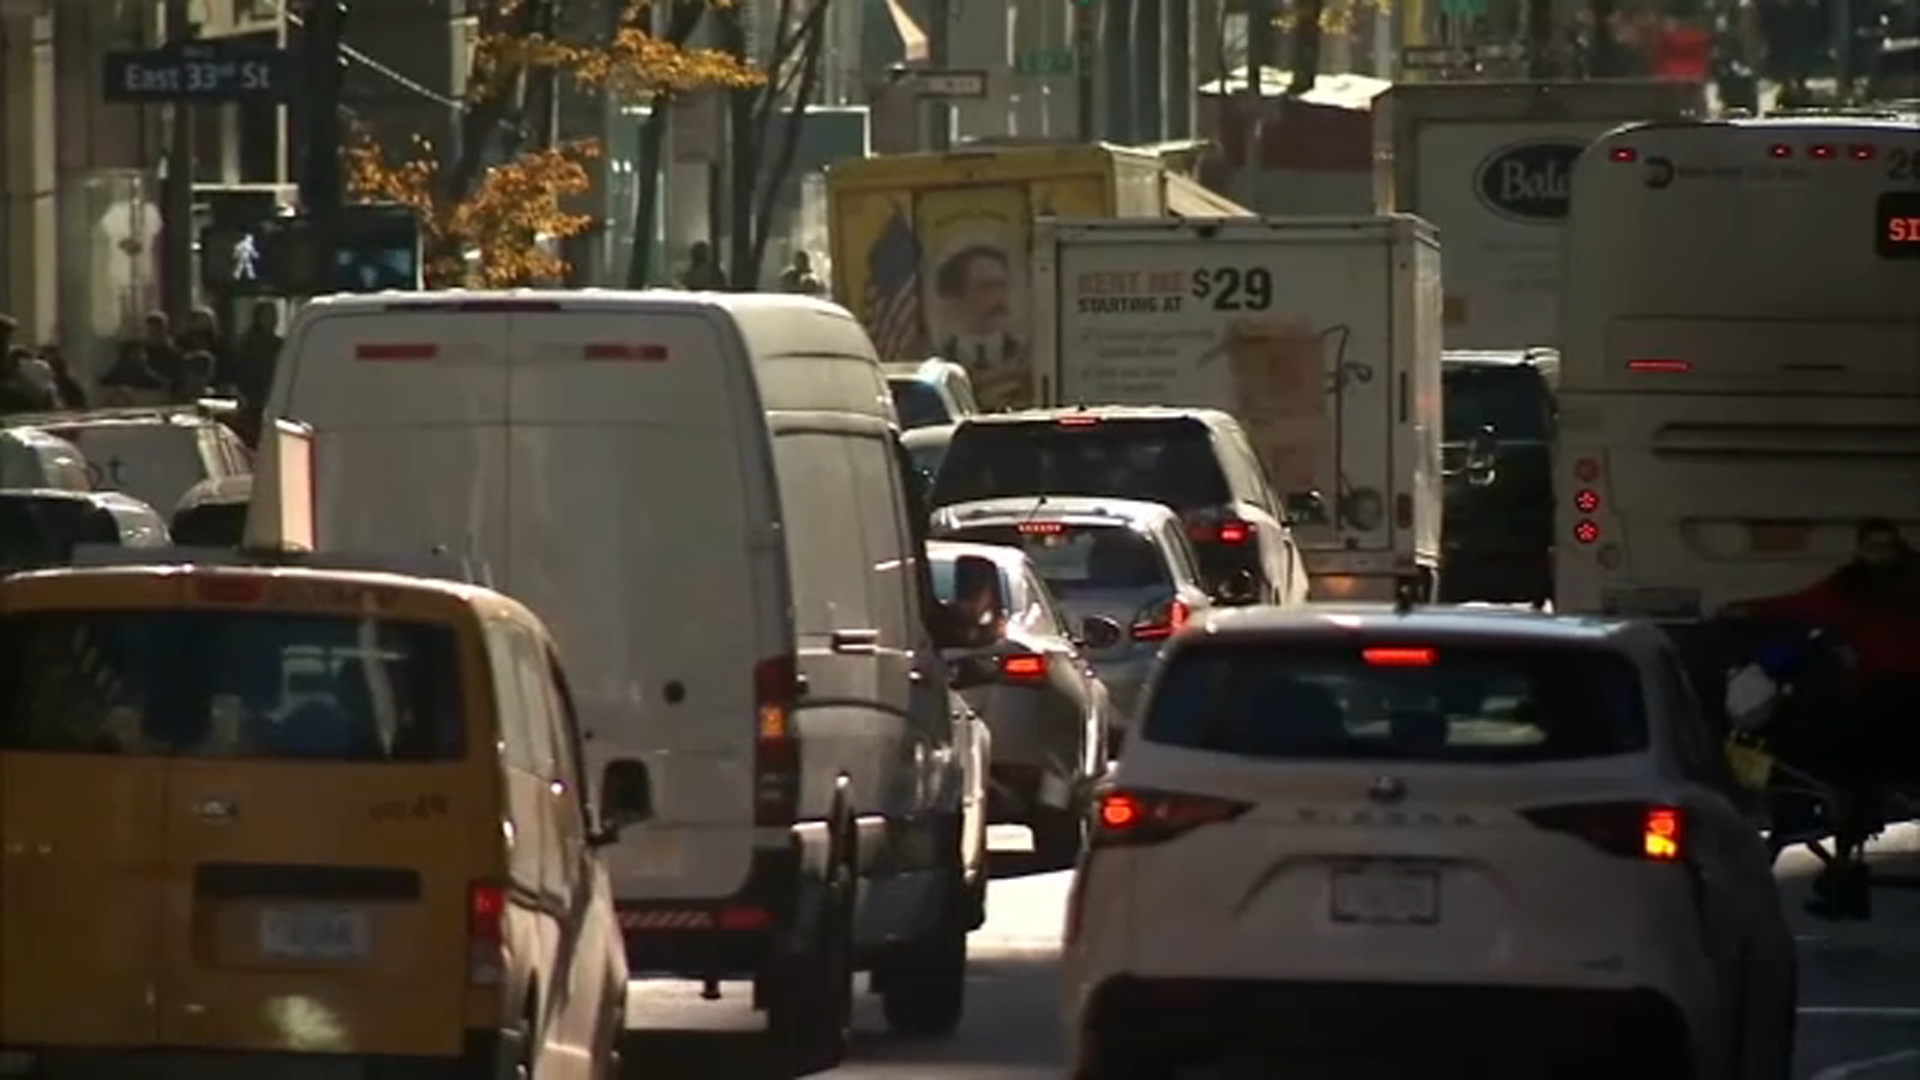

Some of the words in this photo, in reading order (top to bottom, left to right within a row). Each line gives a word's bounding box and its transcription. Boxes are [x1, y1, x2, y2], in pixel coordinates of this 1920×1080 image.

[125, 62, 180, 92] East
[185, 60, 235, 92] 33rd
[241, 60, 271, 90] St
[1077, 296, 1159, 314] STARTING
[1163, 295, 1183, 313] AT
[1191, 266, 1273, 312] $29
